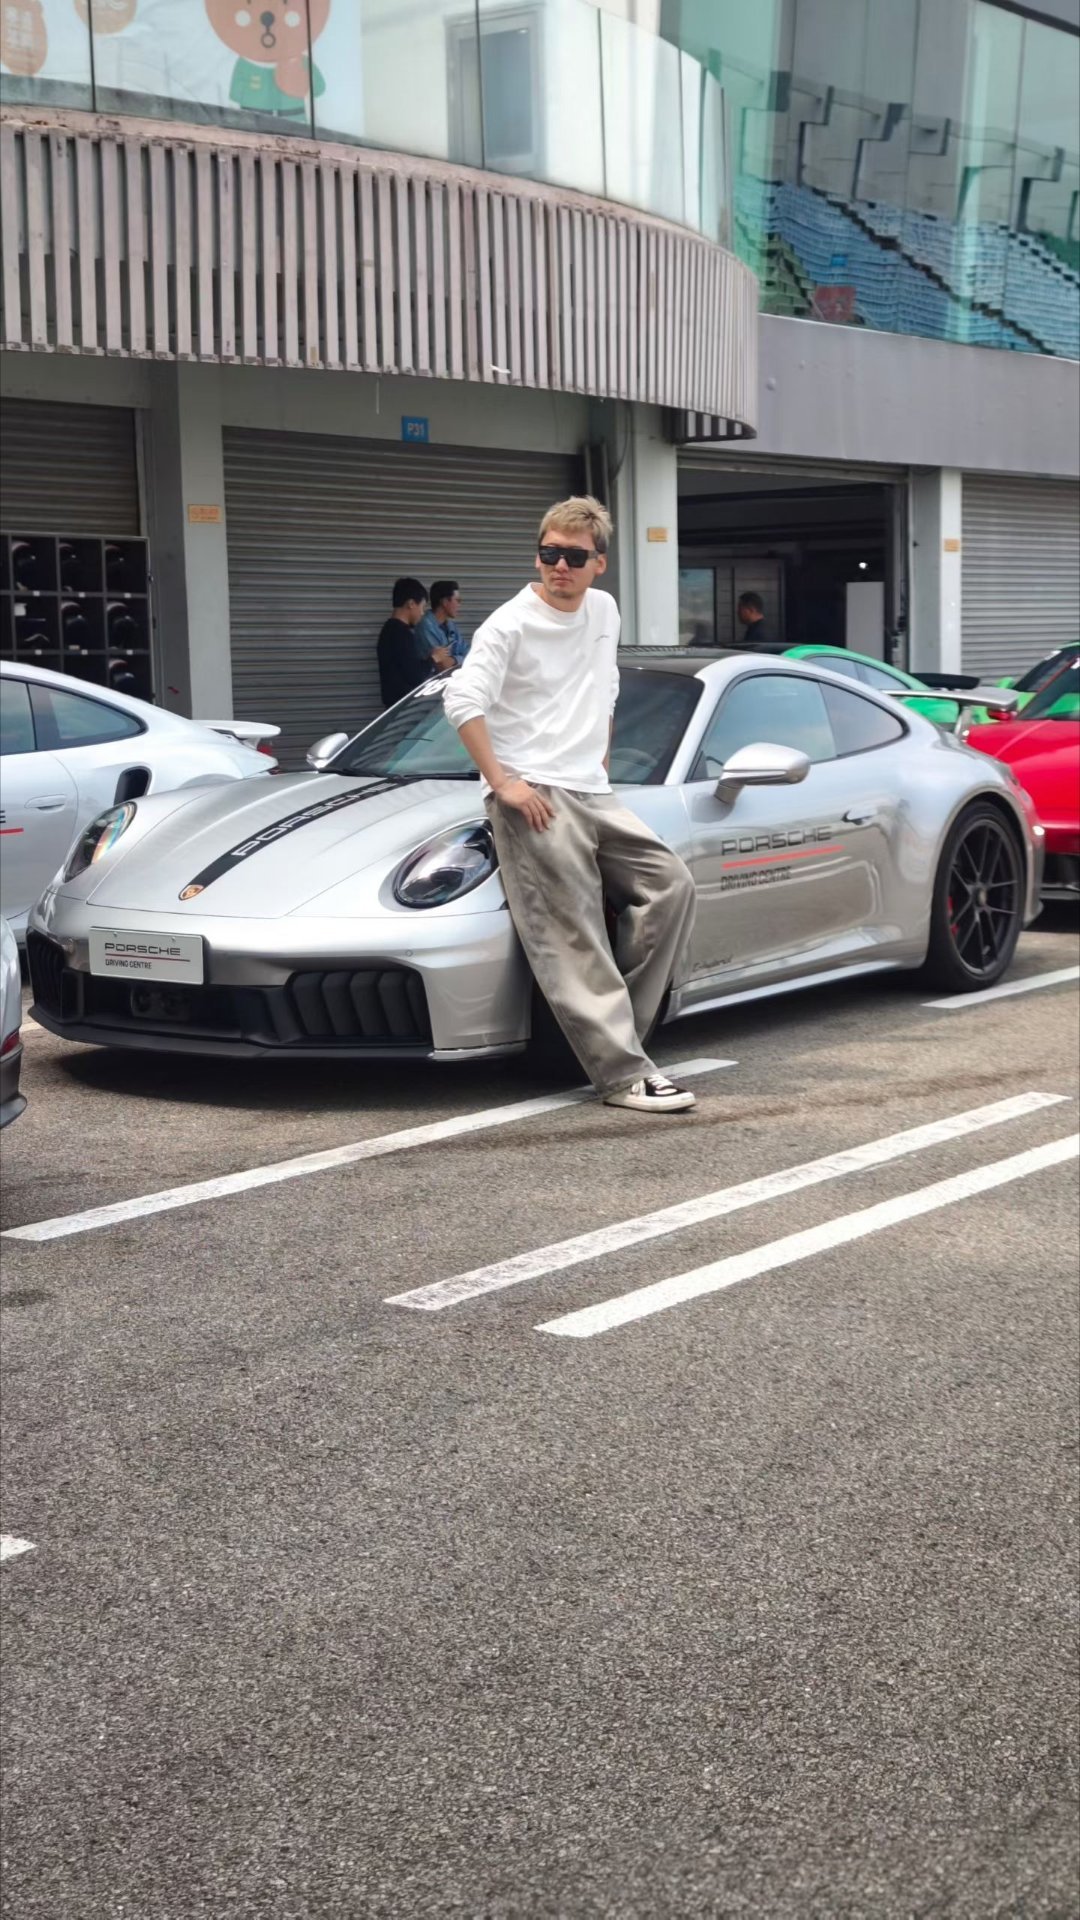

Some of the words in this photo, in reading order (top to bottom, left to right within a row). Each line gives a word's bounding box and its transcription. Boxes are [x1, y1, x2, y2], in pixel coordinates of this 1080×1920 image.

[407, 422, 425, 436] P31
[231, 782, 399, 857] PORSCHE
[721, 825, 833, 856] PORSCHE
[104, 942, 181, 956] PORSCHE
[105, 958, 129, 968] DRIVING
[129, 960, 153, 970] CENTRE
